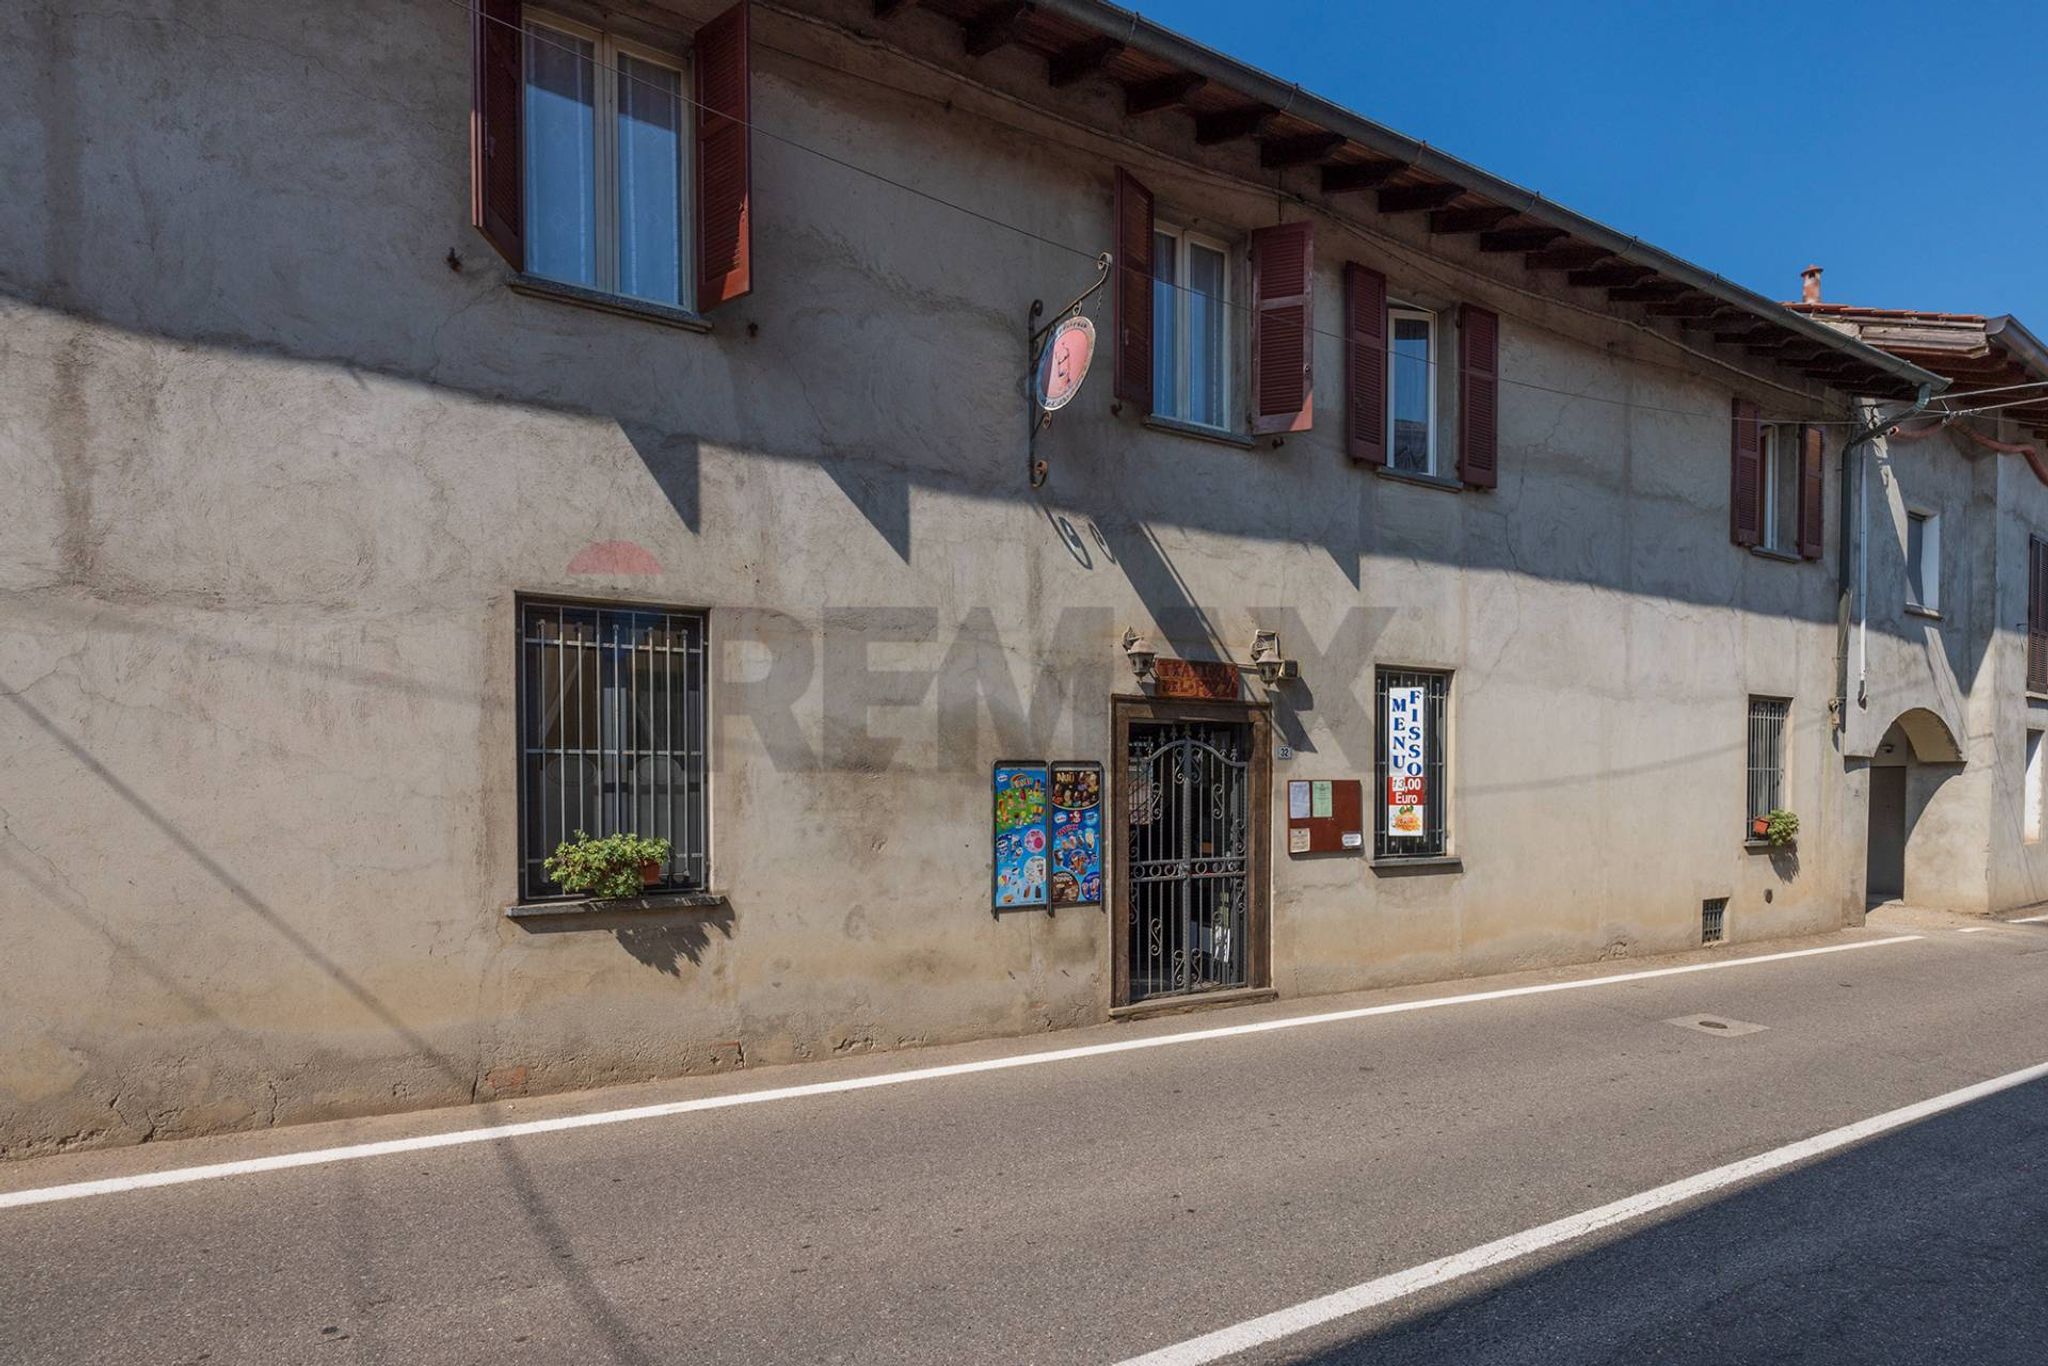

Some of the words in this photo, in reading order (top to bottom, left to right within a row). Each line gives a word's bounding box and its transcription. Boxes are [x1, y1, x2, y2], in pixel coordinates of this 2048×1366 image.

[1392, 698, 1407, 769] MENU
[1407, 690, 1422, 776] FISSO
[1395, 792, 1418, 804] Euro
